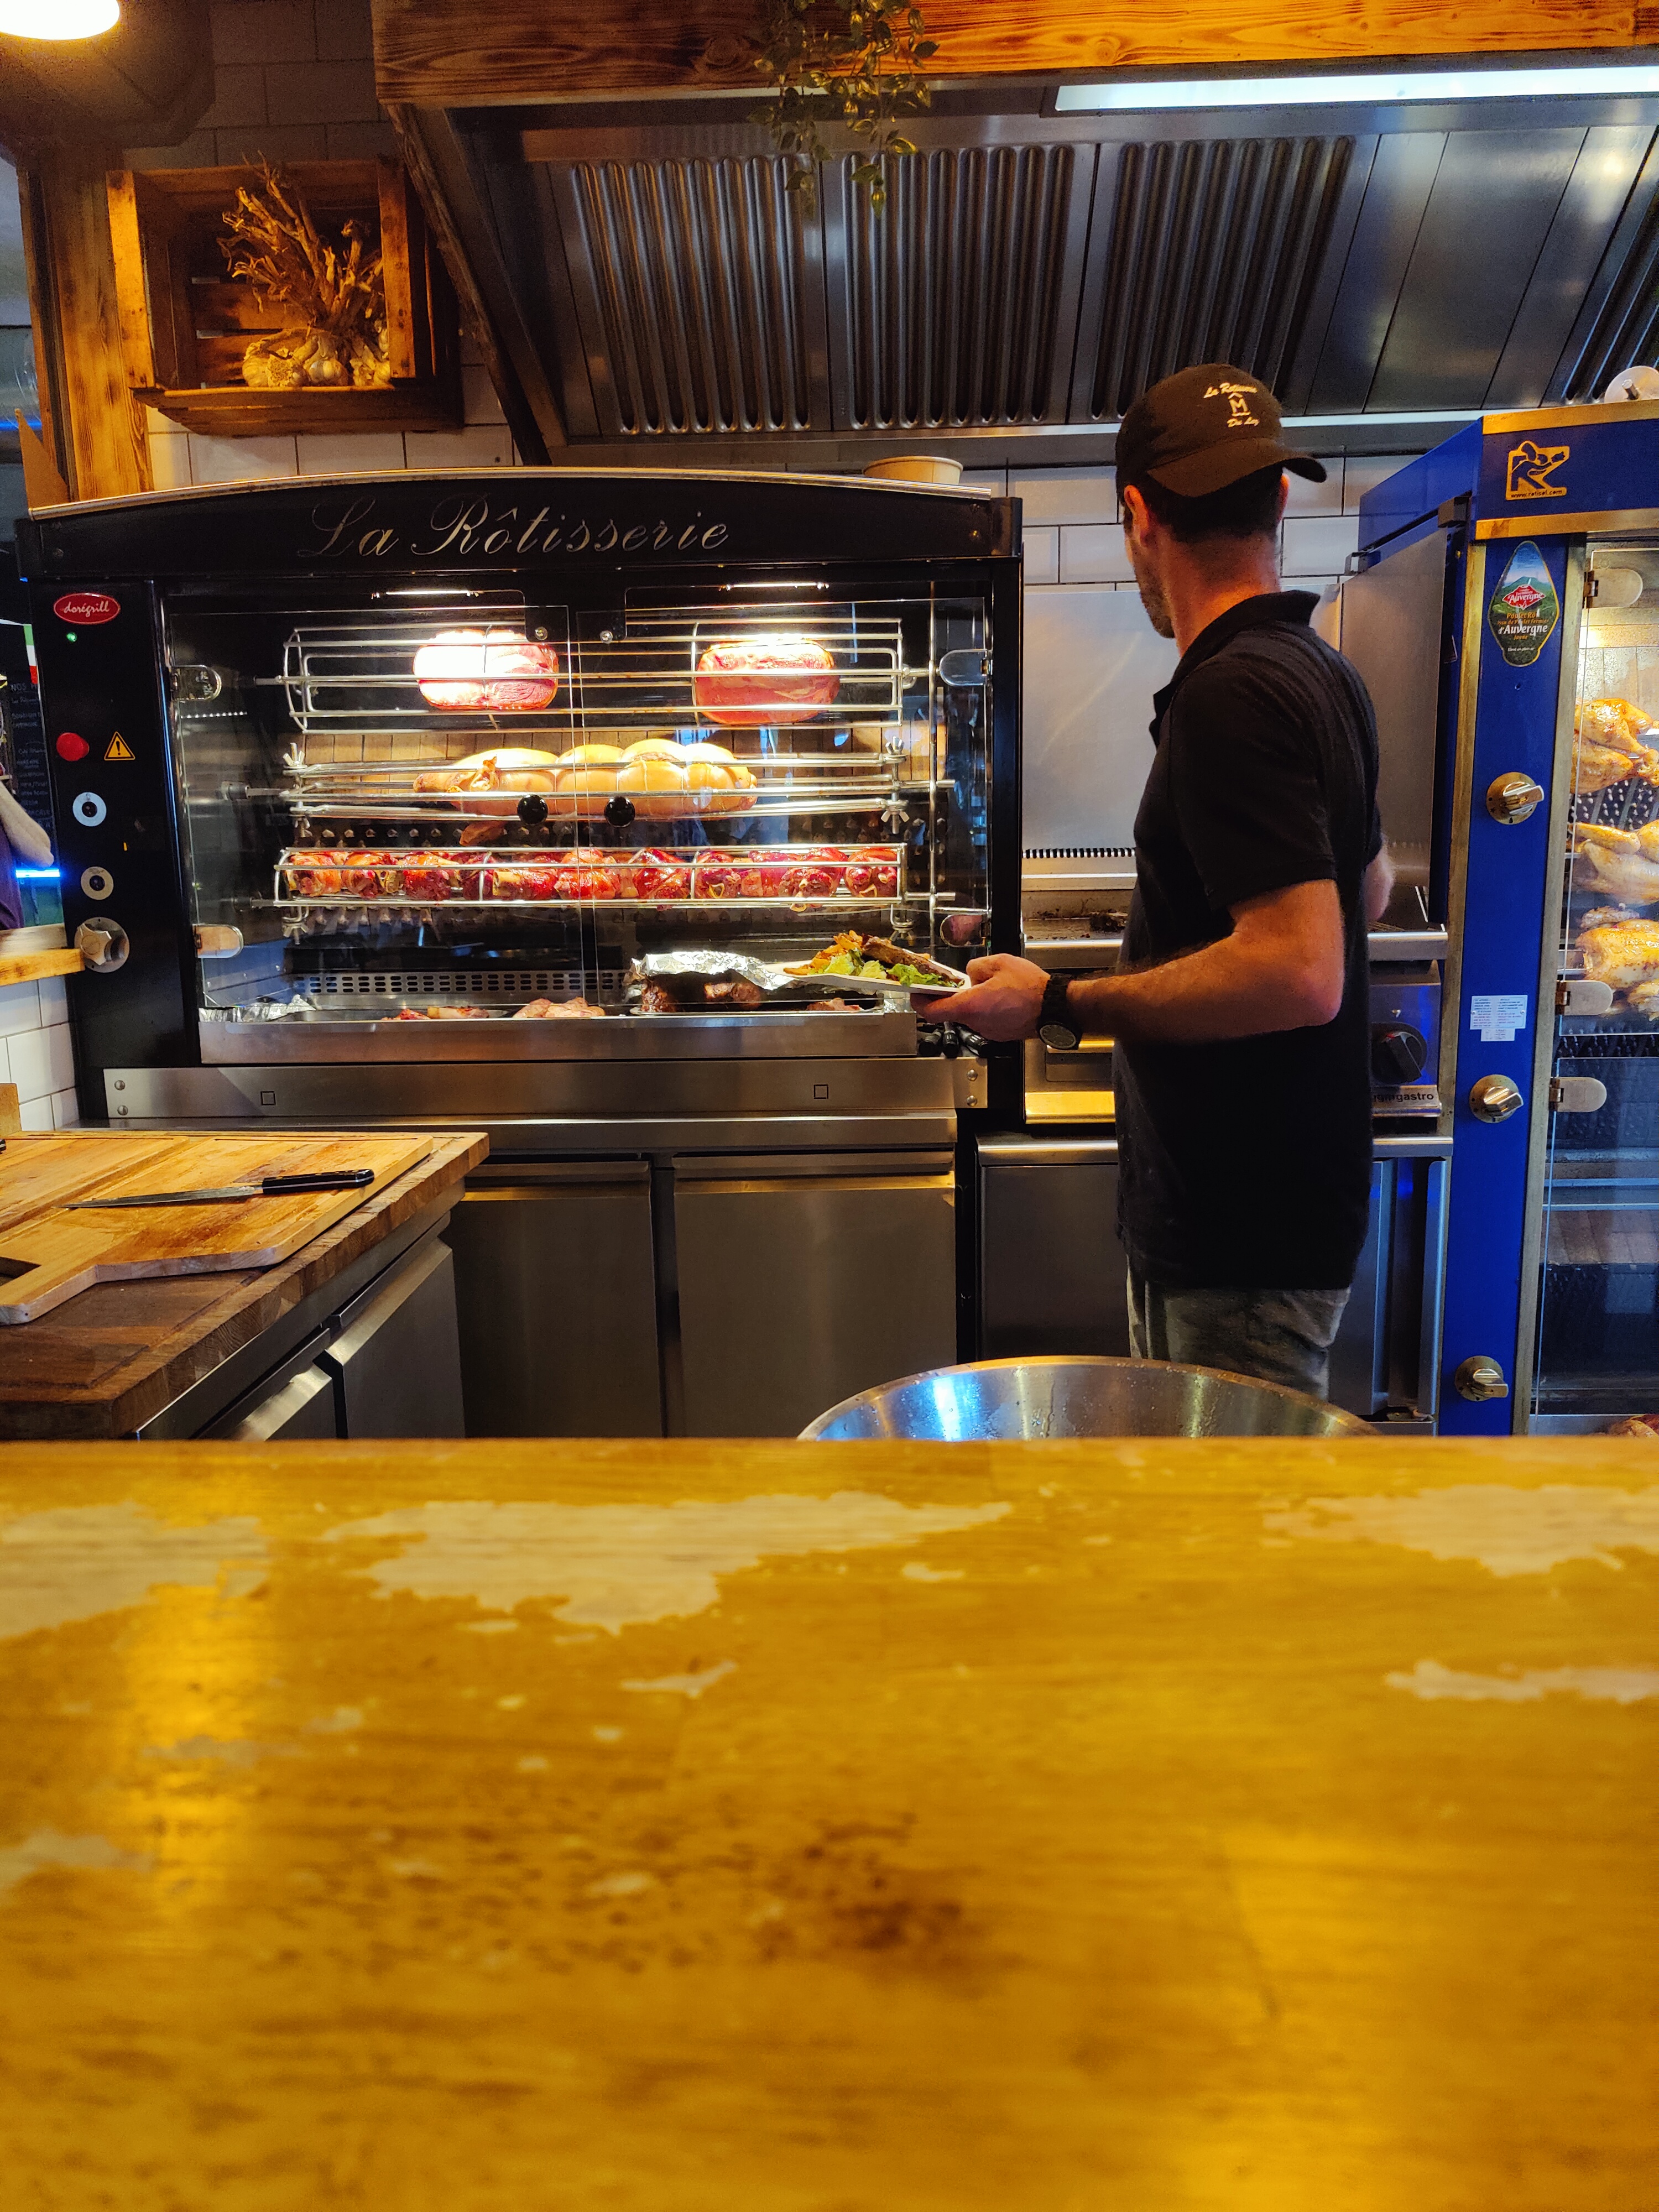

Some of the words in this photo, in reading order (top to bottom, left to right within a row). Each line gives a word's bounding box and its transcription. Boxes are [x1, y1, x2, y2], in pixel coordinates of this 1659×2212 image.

[1510, 489, 1562, 498] www.rotisol.com
[296, 494, 399, 557] La
[411, 491, 731, 556] Rôtisserie
[64, 601, 110, 618] dorégrill
[1498, 624, 1548, 637] d'Auvergne
